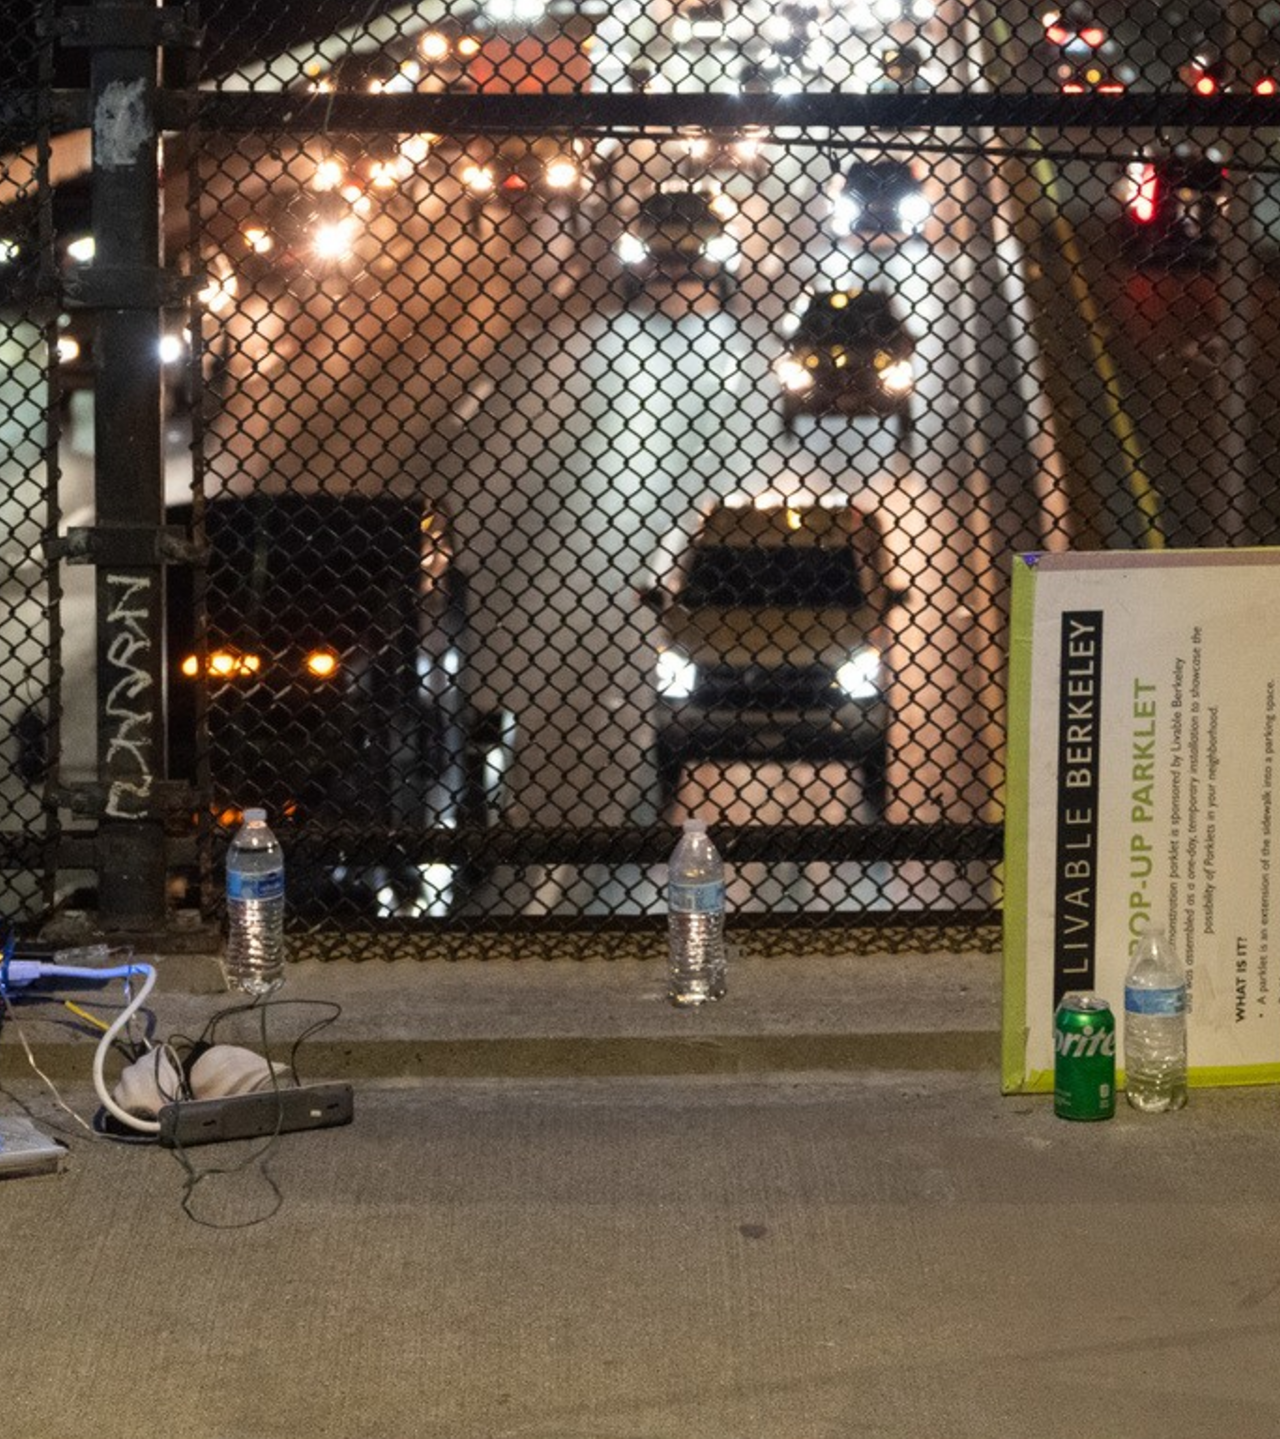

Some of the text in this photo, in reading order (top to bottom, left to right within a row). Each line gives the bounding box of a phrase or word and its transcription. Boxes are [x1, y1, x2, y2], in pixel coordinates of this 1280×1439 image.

[1190, 626, 1202, 644] the
[1189, 647, 1202, 698] showcase
[1189, 702, 1200, 713] to
[1264, 679, 1277, 711] space.
[1130, 678, 1156, 823] PARKLET
[1187, 716, 1199, 774] installation
[1261, 715, 1276, 754] parking
[1261, 766, 1273, 788] into
[1063, 620, 1095, 974] LIVABLE BERKELEY
[1166, 658, 1185, 951] monstration parklet is sponsored by Livable Berkeley
[1187, 776, 1201, 833] temporary
[1259, 791, 1272, 835] sidewalk
[1202, 706, 1220, 935] possibility of Parklets in your neighborhood.
[1258, 858, 1270, 870] of
[1259, 839, 1270, 855] the
[1186, 894, 1195, 905] as
[1259, 873, 1270, 925] extension
[1183, 909, 1196, 965] assembled
[1257, 944, 1268, 952] is
[1259, 929, 1269, 940] an
[1185, 970, 1194, 990] was
[1234, 937, 1248, 1023] WHAT IS IT?
[1256, 955, 1270, 992] parklet
[1256, 995, 1267, 1005] A
